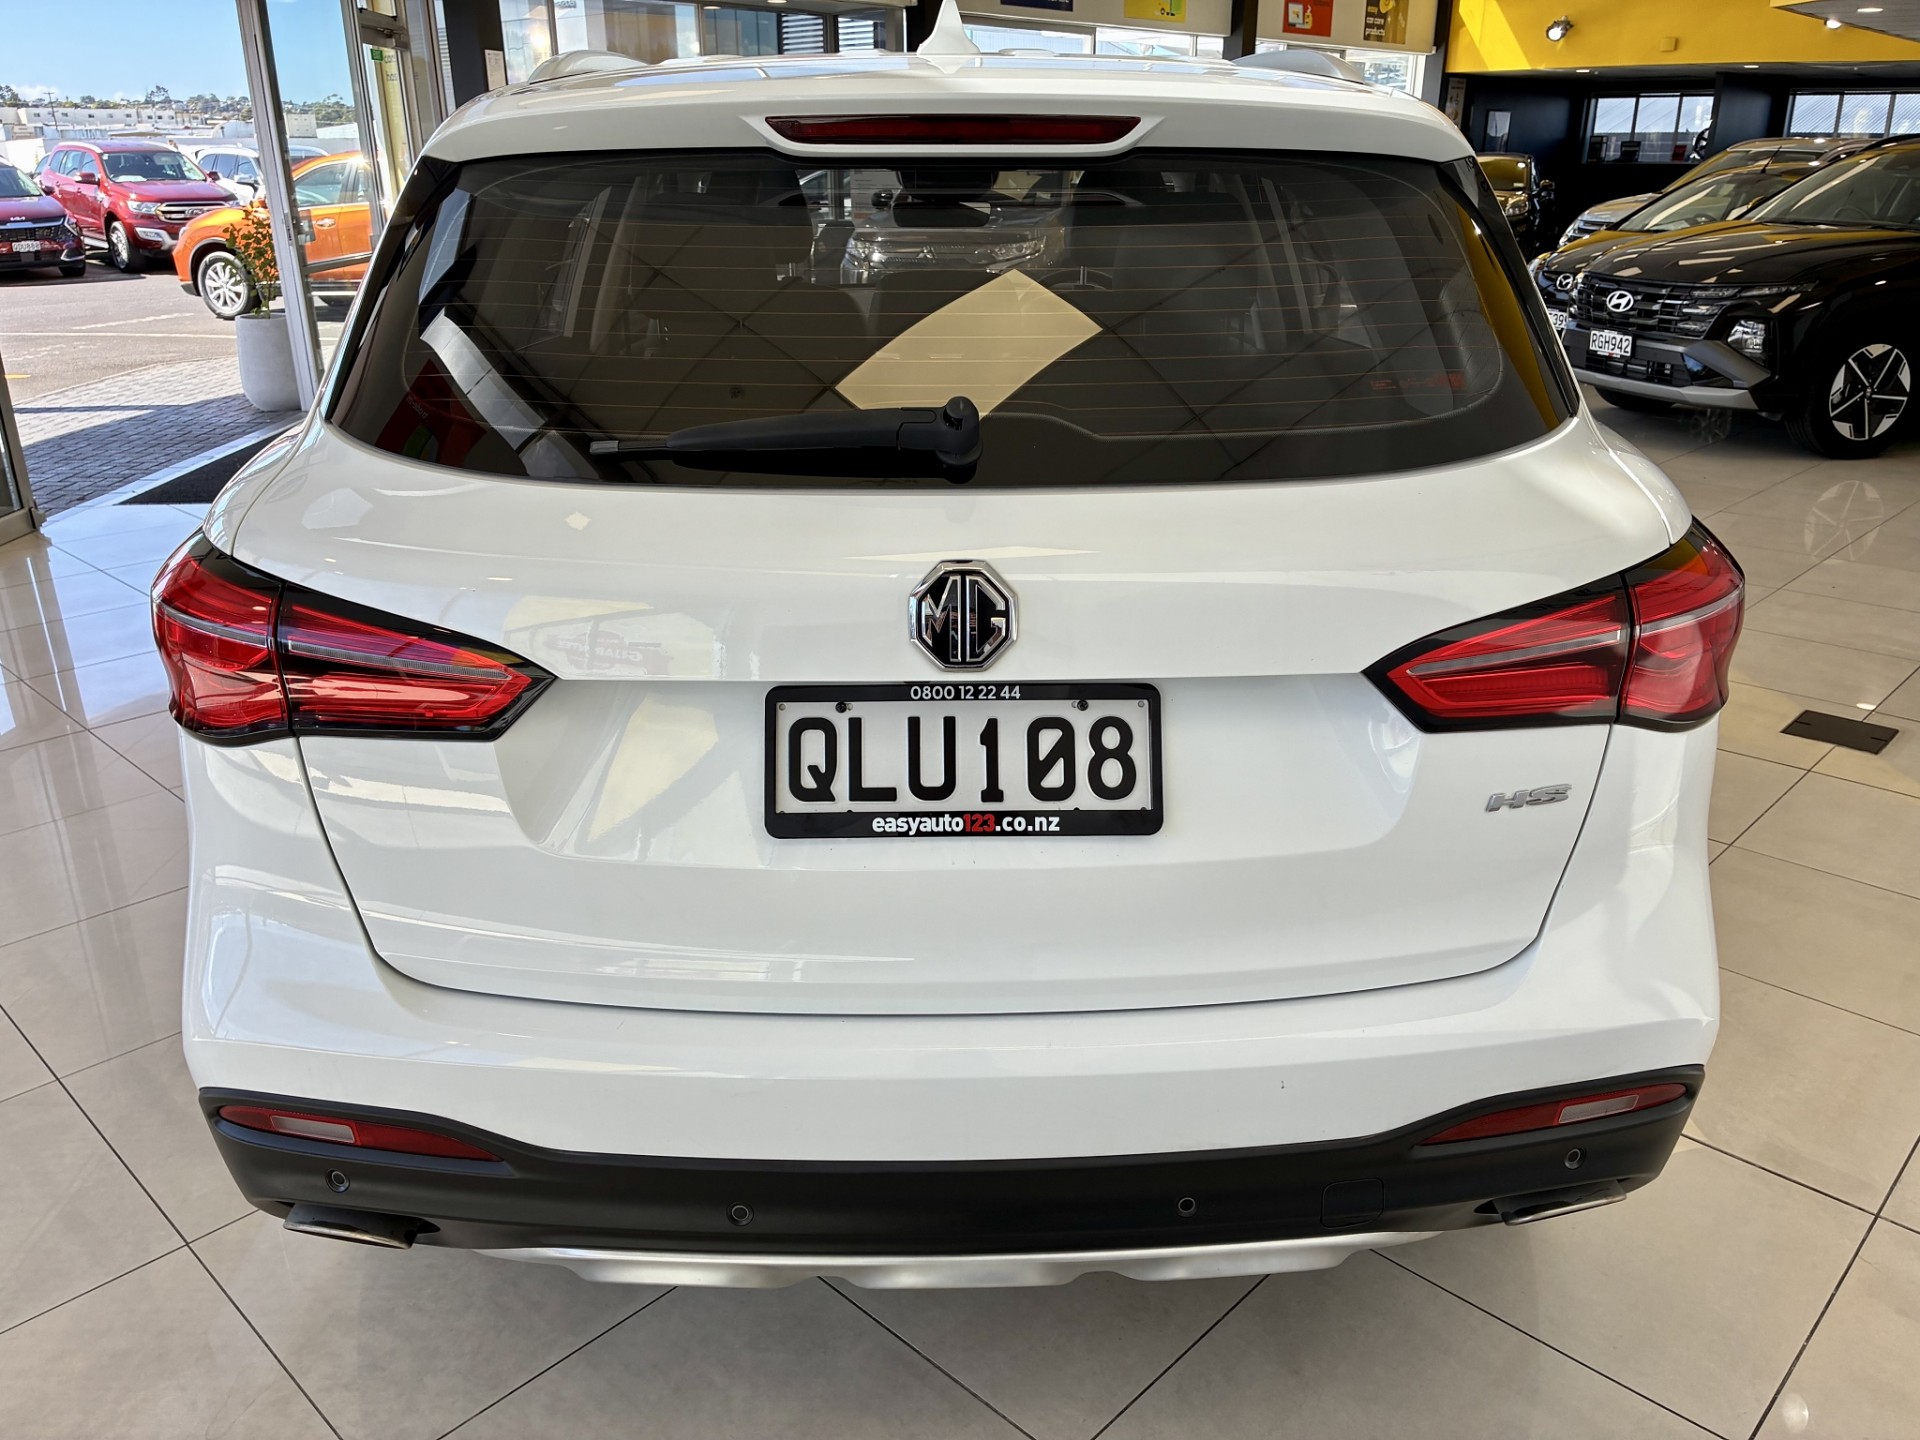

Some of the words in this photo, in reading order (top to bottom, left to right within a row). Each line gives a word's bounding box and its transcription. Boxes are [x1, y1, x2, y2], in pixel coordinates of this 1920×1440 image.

[1591, 333, 1631, 354] RGH942
[921, 574, 1007, 663] MG
[910, 685, 955, 700] 0800
[958, 685, 975, 700] 12
[978, 685, 997, 700] 22
[1000, 685, 1021, 700] 44
[788, 715, 1137, 803] QLU108
[1485, 784, 1573, 812] HS
[872, 813, 1061, 836] easyauto123.co.nz
